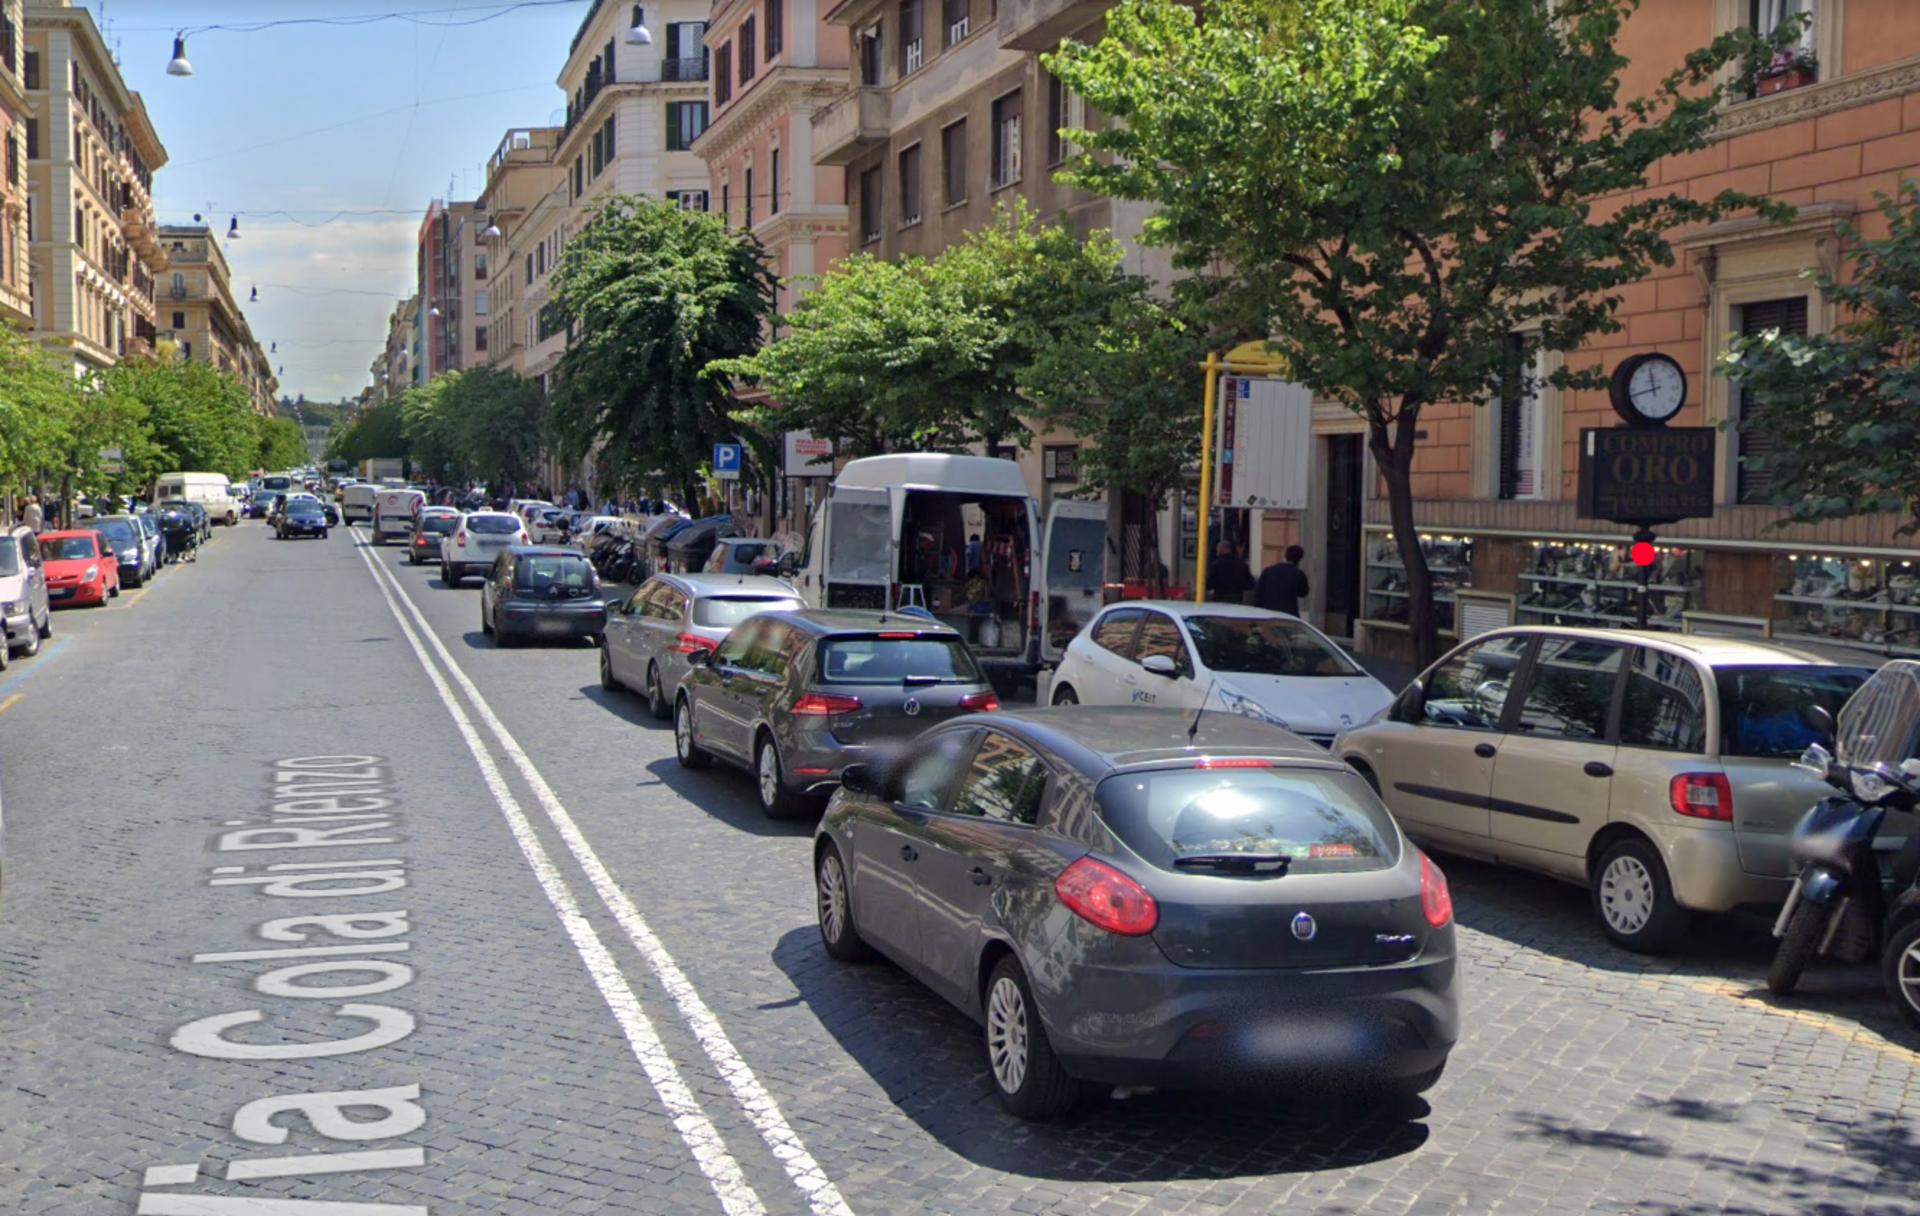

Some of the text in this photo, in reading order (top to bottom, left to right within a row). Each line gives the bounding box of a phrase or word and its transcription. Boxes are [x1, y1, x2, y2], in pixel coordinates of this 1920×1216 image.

[1603, 436, 1709, 452] COMPRO
[719, 447, 735, 468] P
[1611, 453, 1697, 485] ORO
